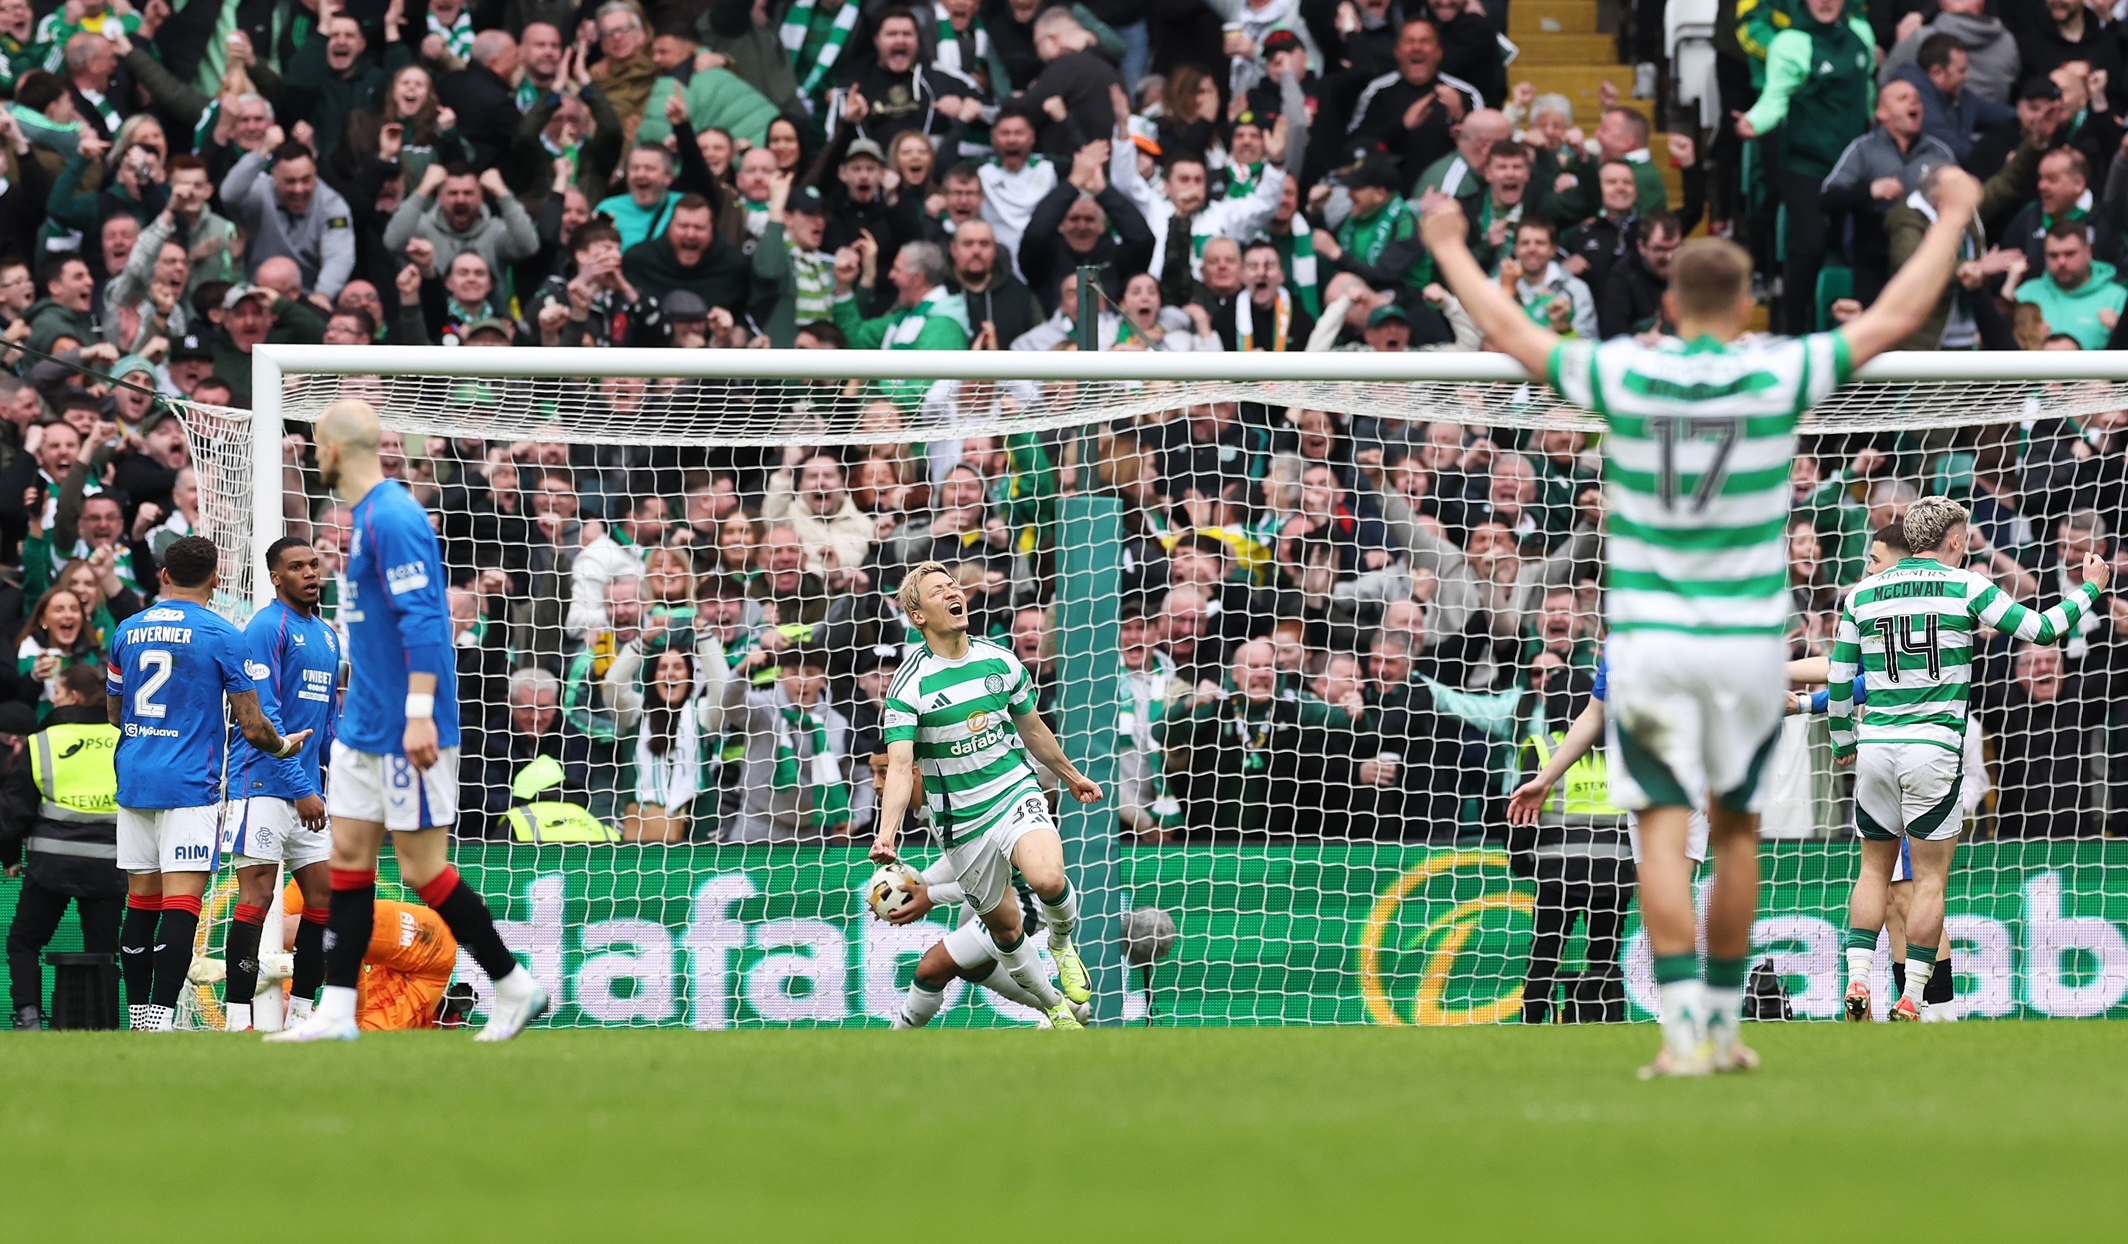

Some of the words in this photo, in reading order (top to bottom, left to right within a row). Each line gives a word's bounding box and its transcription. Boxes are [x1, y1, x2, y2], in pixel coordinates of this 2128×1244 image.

[1643, 416, 1747, 515] 17
[1878, 569, 1947, 581] MAGNERS
[127, 626, 193, 644] TAVERNIER
[1874, 612, 1941, 684] 14
[134, 650, 173, 718] 2
[138, 726, 179, 738] MyGuava
[85, 737, 114, 750] PSG
[175, 845, 209, 860] AIM
[401, 911, 415, 947] AIM
